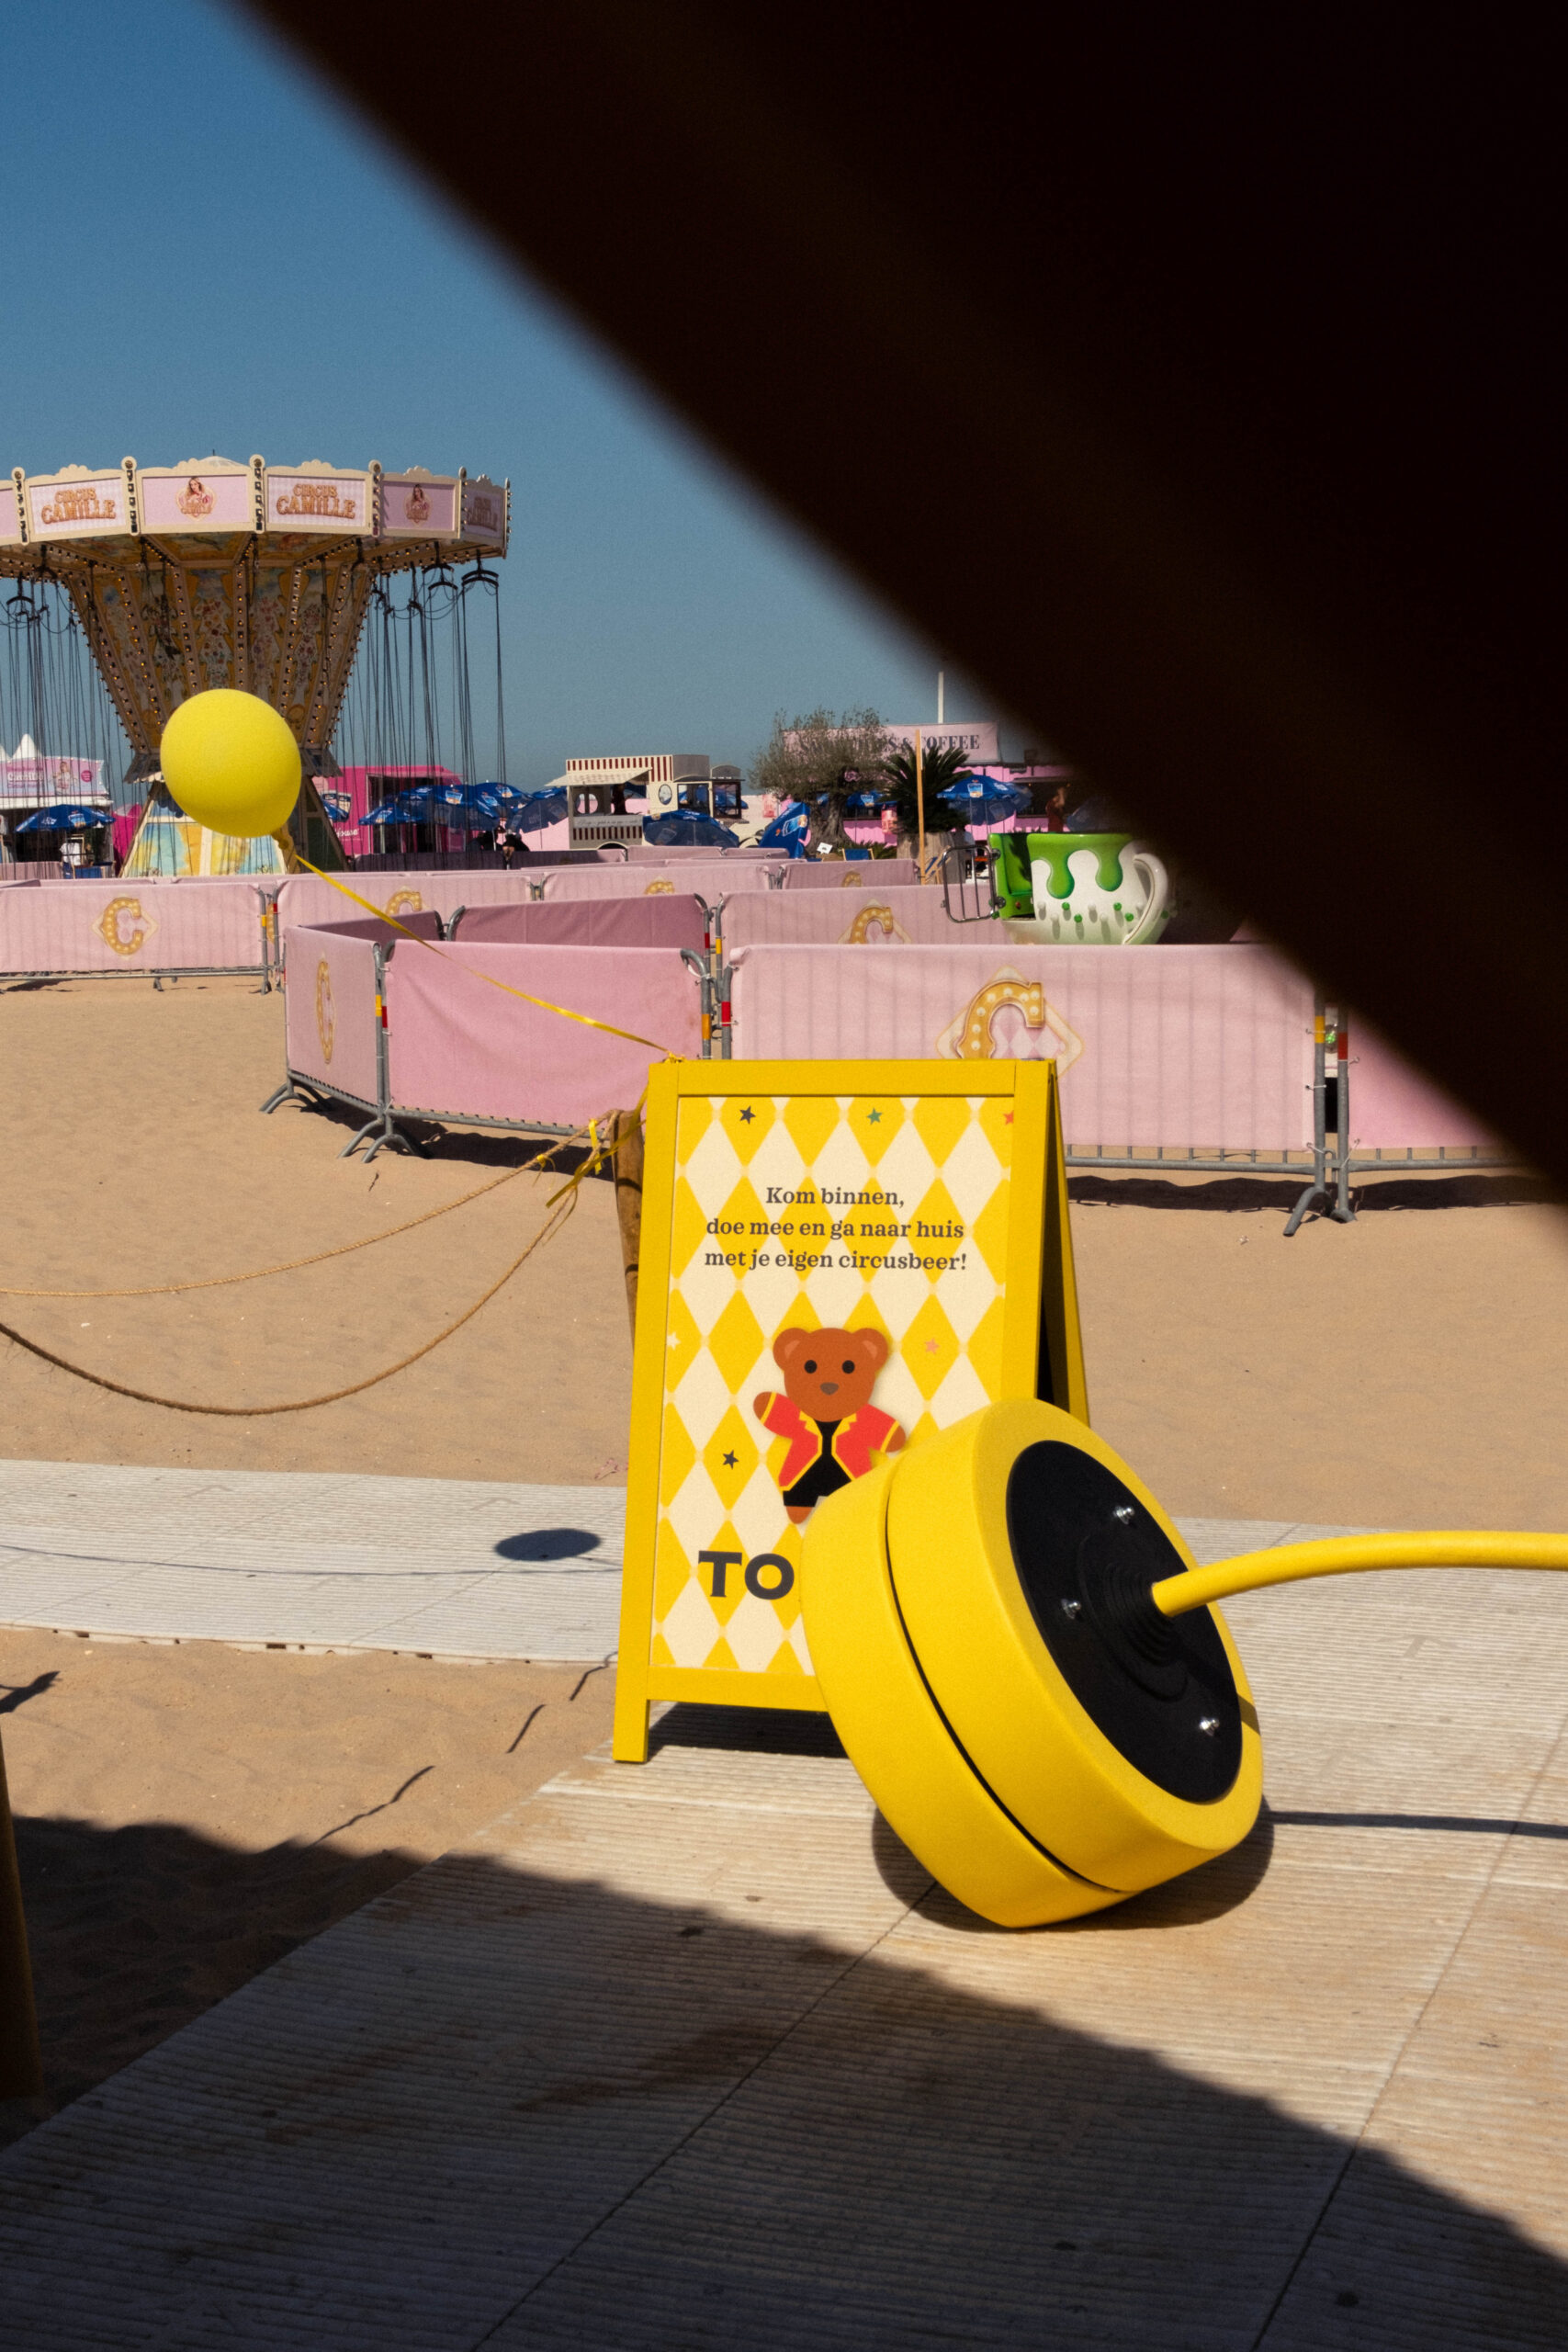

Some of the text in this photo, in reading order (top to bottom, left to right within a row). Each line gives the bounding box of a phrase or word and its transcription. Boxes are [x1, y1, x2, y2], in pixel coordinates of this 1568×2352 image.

[54, 487, 96, 503] CIRCUS
[293, 483, 338, 499] CIRCUS
[41, 500, 117, 525] CAMILLE
[276, 495, 356, 520] CAMILLE
[921, 734, 980, 750] OFFEE
[765, 1187, 905, 1208] Kom binnen,
[706, 1218, 964, 1240] doe mee en ga naar huis
[705, 1249, 967, 1272] met je eigen circusbeer!
[698, 1550, 795, 1600] TO
